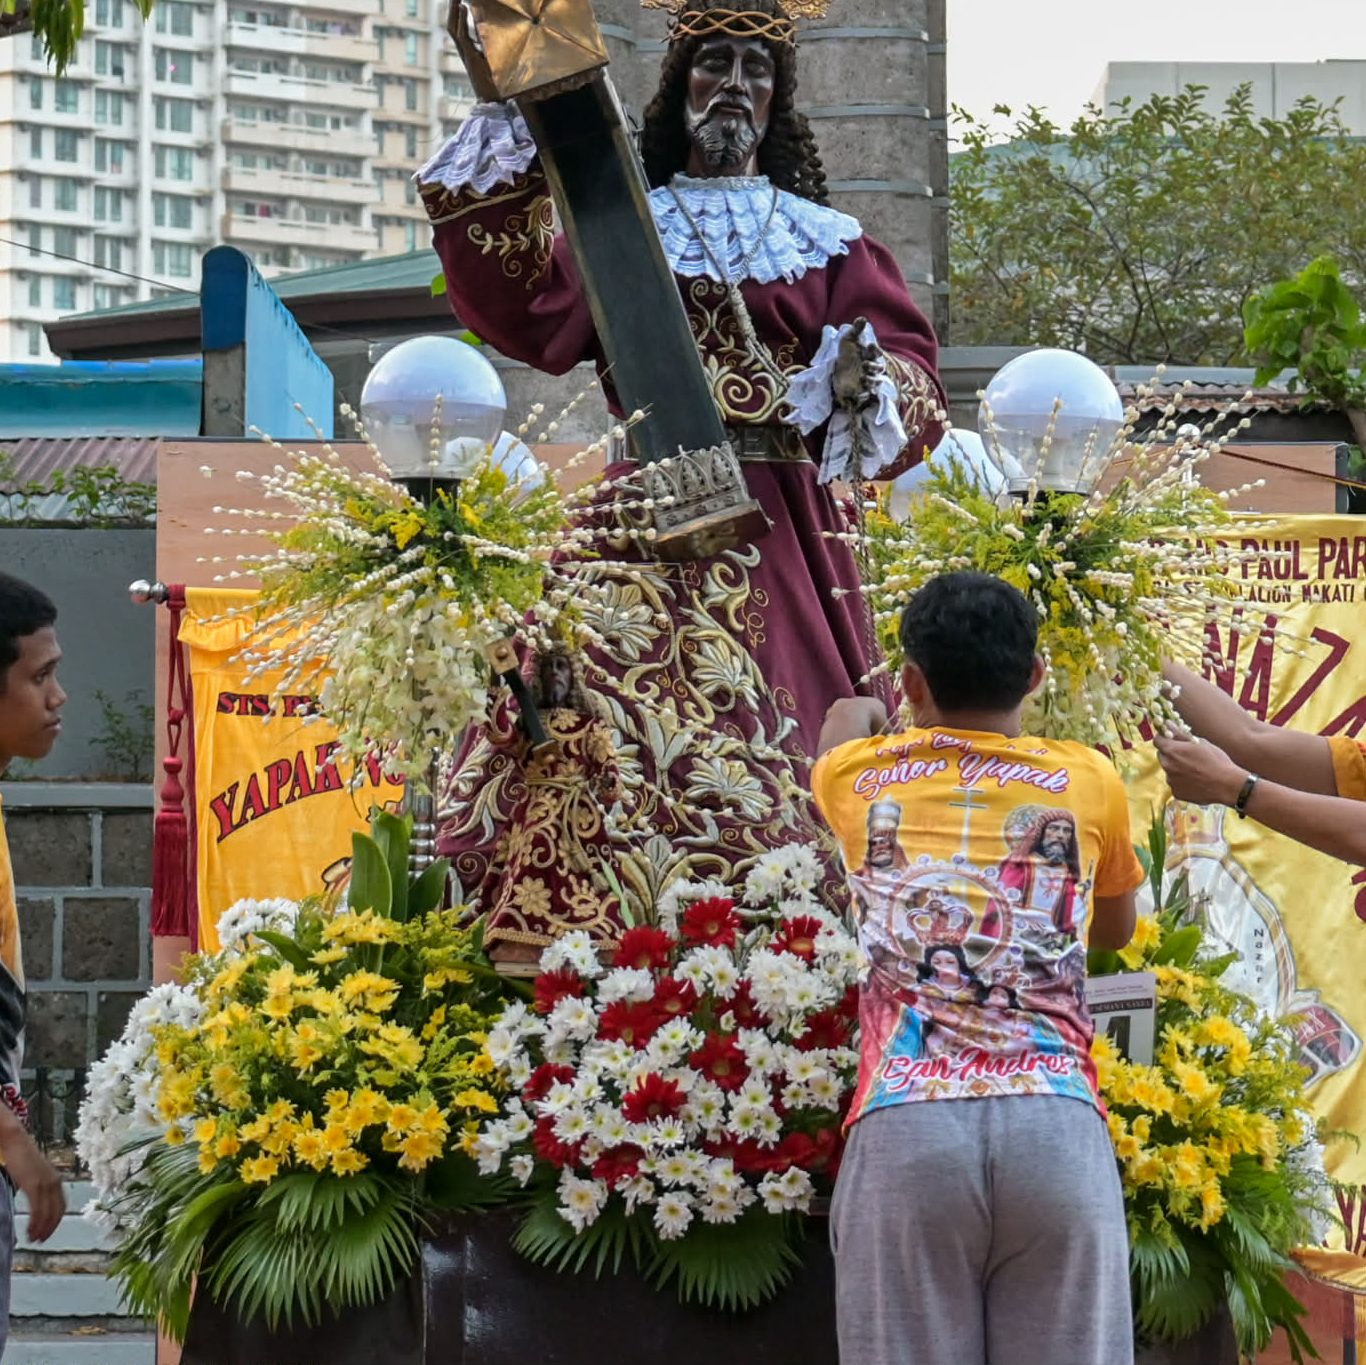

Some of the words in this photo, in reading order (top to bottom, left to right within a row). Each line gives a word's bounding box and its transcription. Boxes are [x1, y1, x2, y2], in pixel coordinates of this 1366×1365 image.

[1241, 537, 1308, 580] PAUL
[209, 740, 344, 844] YAPAK
[853, 756, 949, 800] Señor
[957, 752, 1070, 794] Yapak
[883, 1055, 953, 1092] San
[952, 1045, 1074, 1082] Andres
